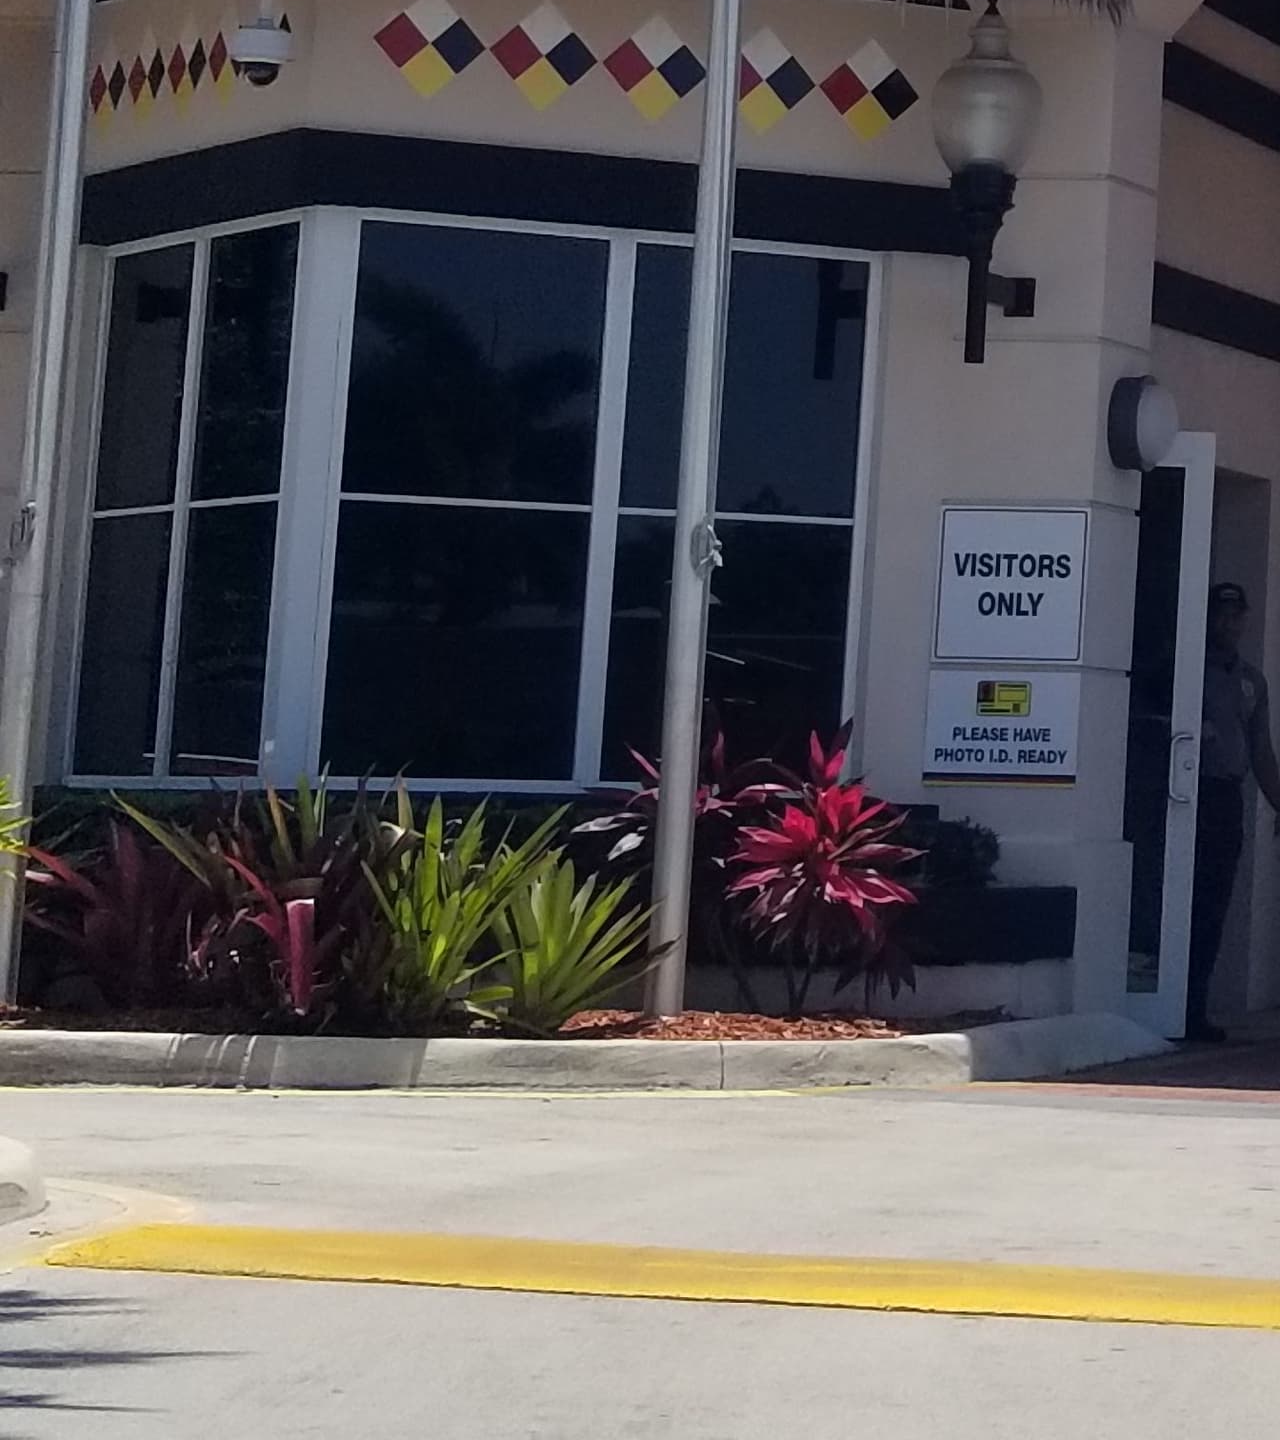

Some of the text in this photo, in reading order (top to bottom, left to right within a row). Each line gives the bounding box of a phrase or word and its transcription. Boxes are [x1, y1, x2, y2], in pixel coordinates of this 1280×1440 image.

[954, 553, 1071, 578] VISITORS
[978, 592, 1044, 617] ONLY
[952, 727, 1051, 742] PLEASE HAVE
[934, 748, 1067, 764] PHOTO I.D. READY
